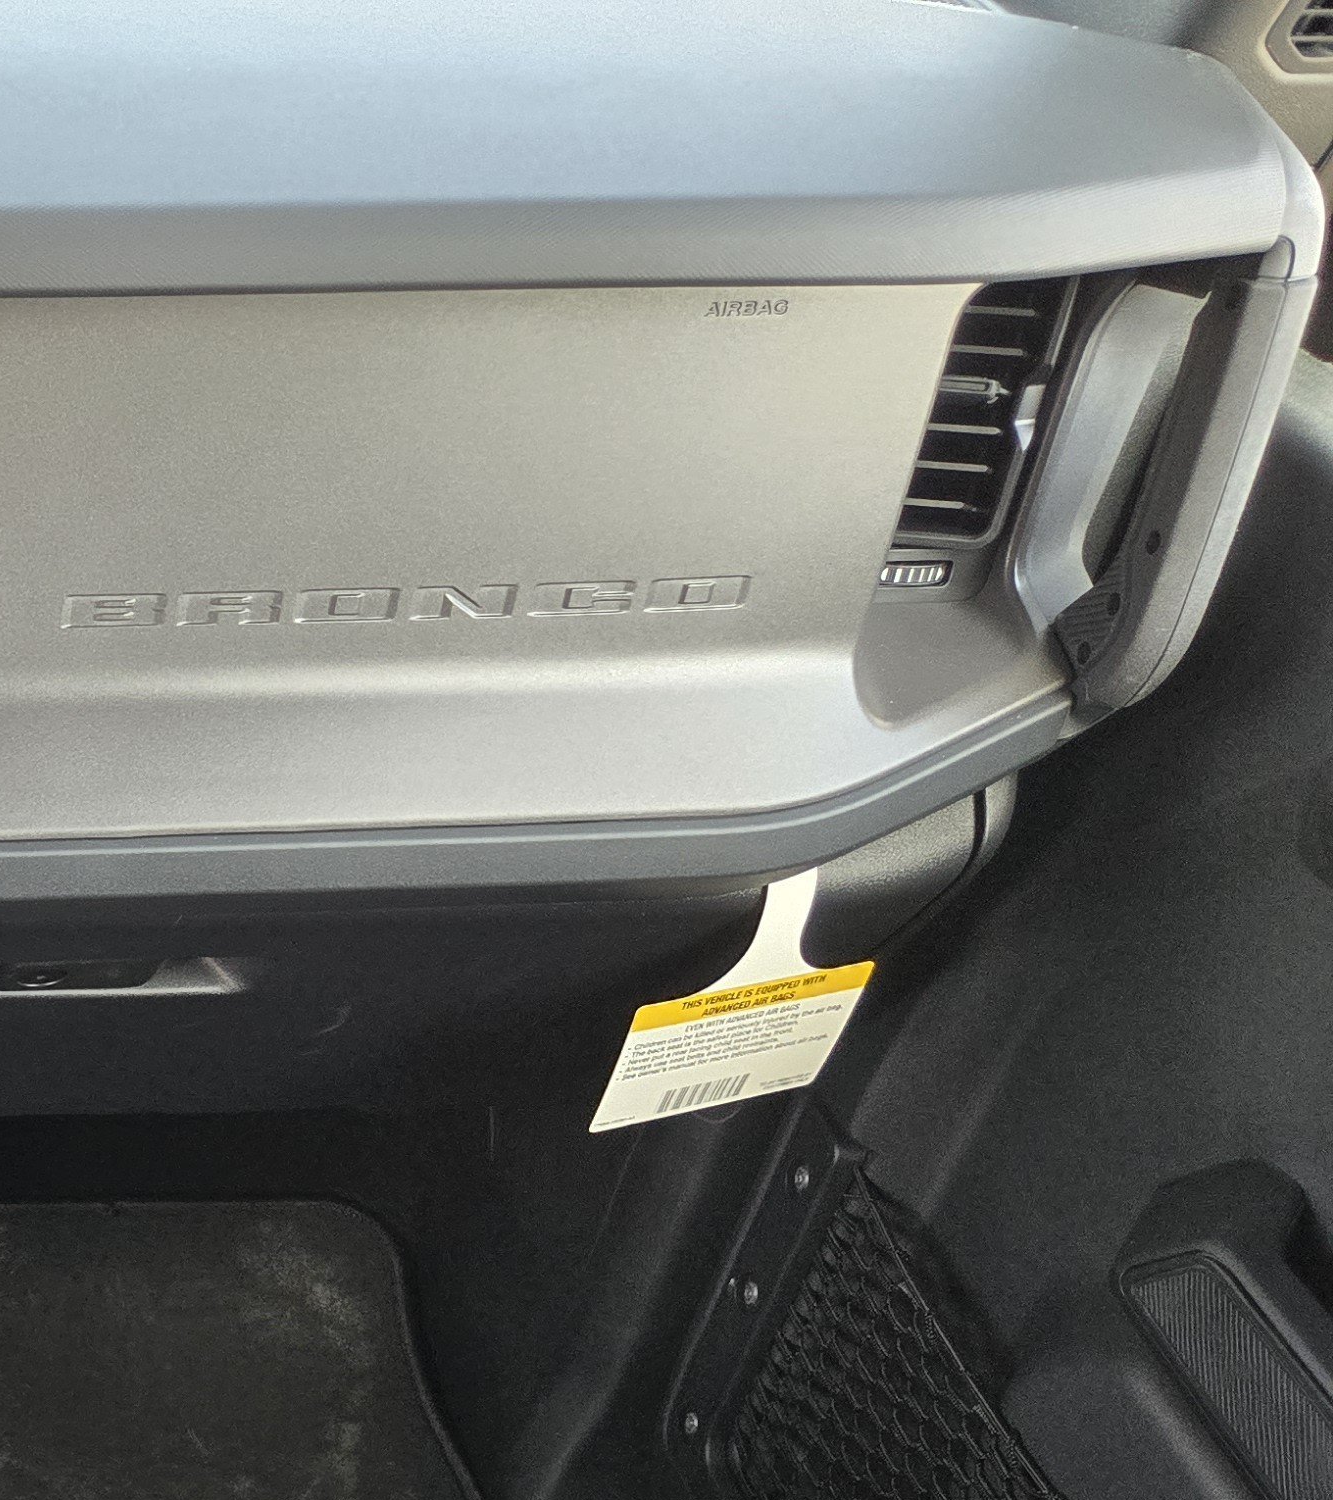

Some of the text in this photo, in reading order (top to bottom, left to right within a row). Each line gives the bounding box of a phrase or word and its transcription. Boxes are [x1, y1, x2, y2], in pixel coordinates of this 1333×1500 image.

[702, 299, 789, 318] AIRBAG
[59, 574, 753, 630] BRONCO
[680, 974, 827, 1009] THIS VEHICLE IS EQUIPPED WITH
[701, 991, 796, 1016] ADVANCED AIR BAGS
[684, 1022, 704, 1031] EVEN
[705, 1018, 725, 1027] WITH
[725, 1010, 765, 1023] ADVANCED
[779, 1003, 801, 1012] BAGS
